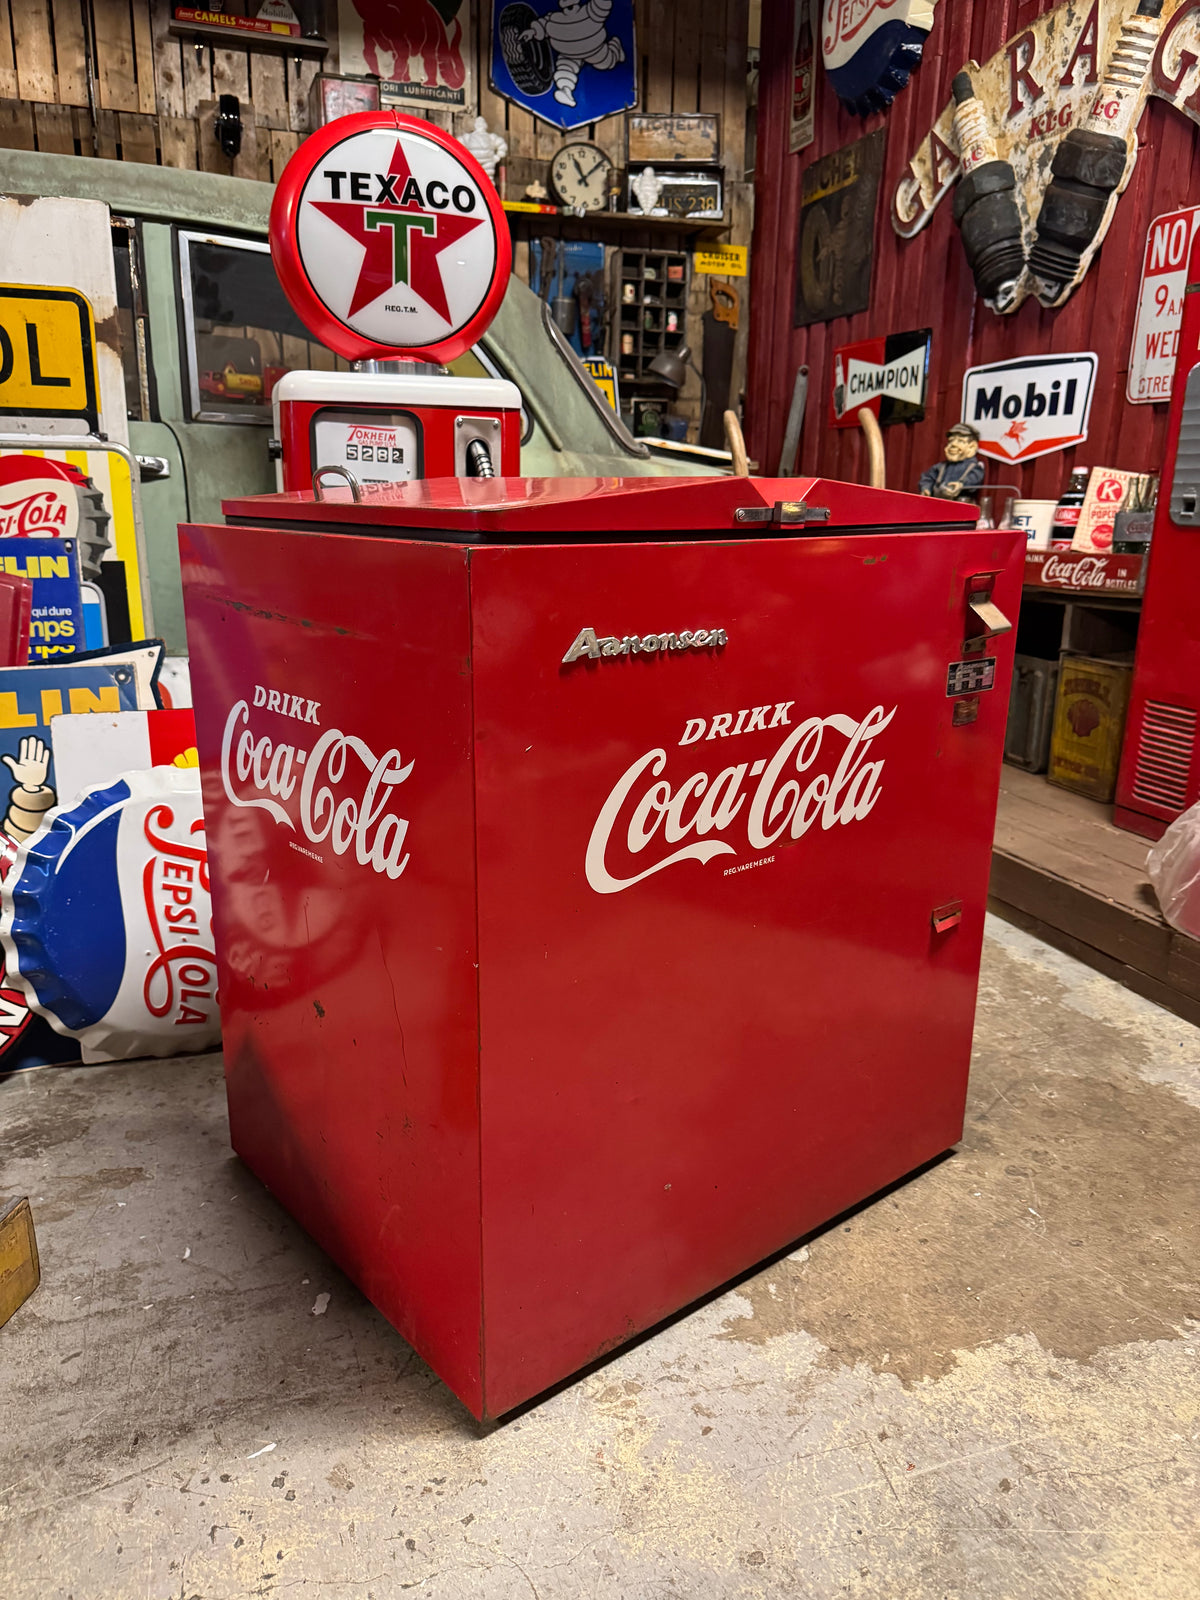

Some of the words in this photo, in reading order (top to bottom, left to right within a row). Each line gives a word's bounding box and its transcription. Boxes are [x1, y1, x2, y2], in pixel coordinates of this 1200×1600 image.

[194, 10, 237, 26] CAMELS
[403, 85, 461, 100] LUBRIFICANTI
[630, 118, 714, 131] MICHELIN
[578, 150, 586, 158] 12
[323, 171, 476, 213] TEXACO
[364, 208, 437, 285] T
[702, 251, 740, 261] CRUISER
[1149, 218, 1187, 270] NO
[0, 322, 71, 387] L
[849, 365, 920, 394] CHAMPION
[1138, 375, 1174, 395] STRE
[974, 378, 1078, 421] Mobil
[347, 424, 398, 442] TOKHEIM
[1099, 481, 1120, 501] K
[0, 556, 70, 579] LIN
[1041, 555, 1110, 587] Coca-Cola
[1105, 578, 1138, 590] BOTTLES
[31, 607, 47, 618] qui
[48, 607, 72, 616] dure
[253, 685, 321, 726] DRIKK
[678, 701, 795, 746] DRIKK
[220, 699, 416, 880] Coca-Cola
[584, 704, 898, 894] Coca-Cola
